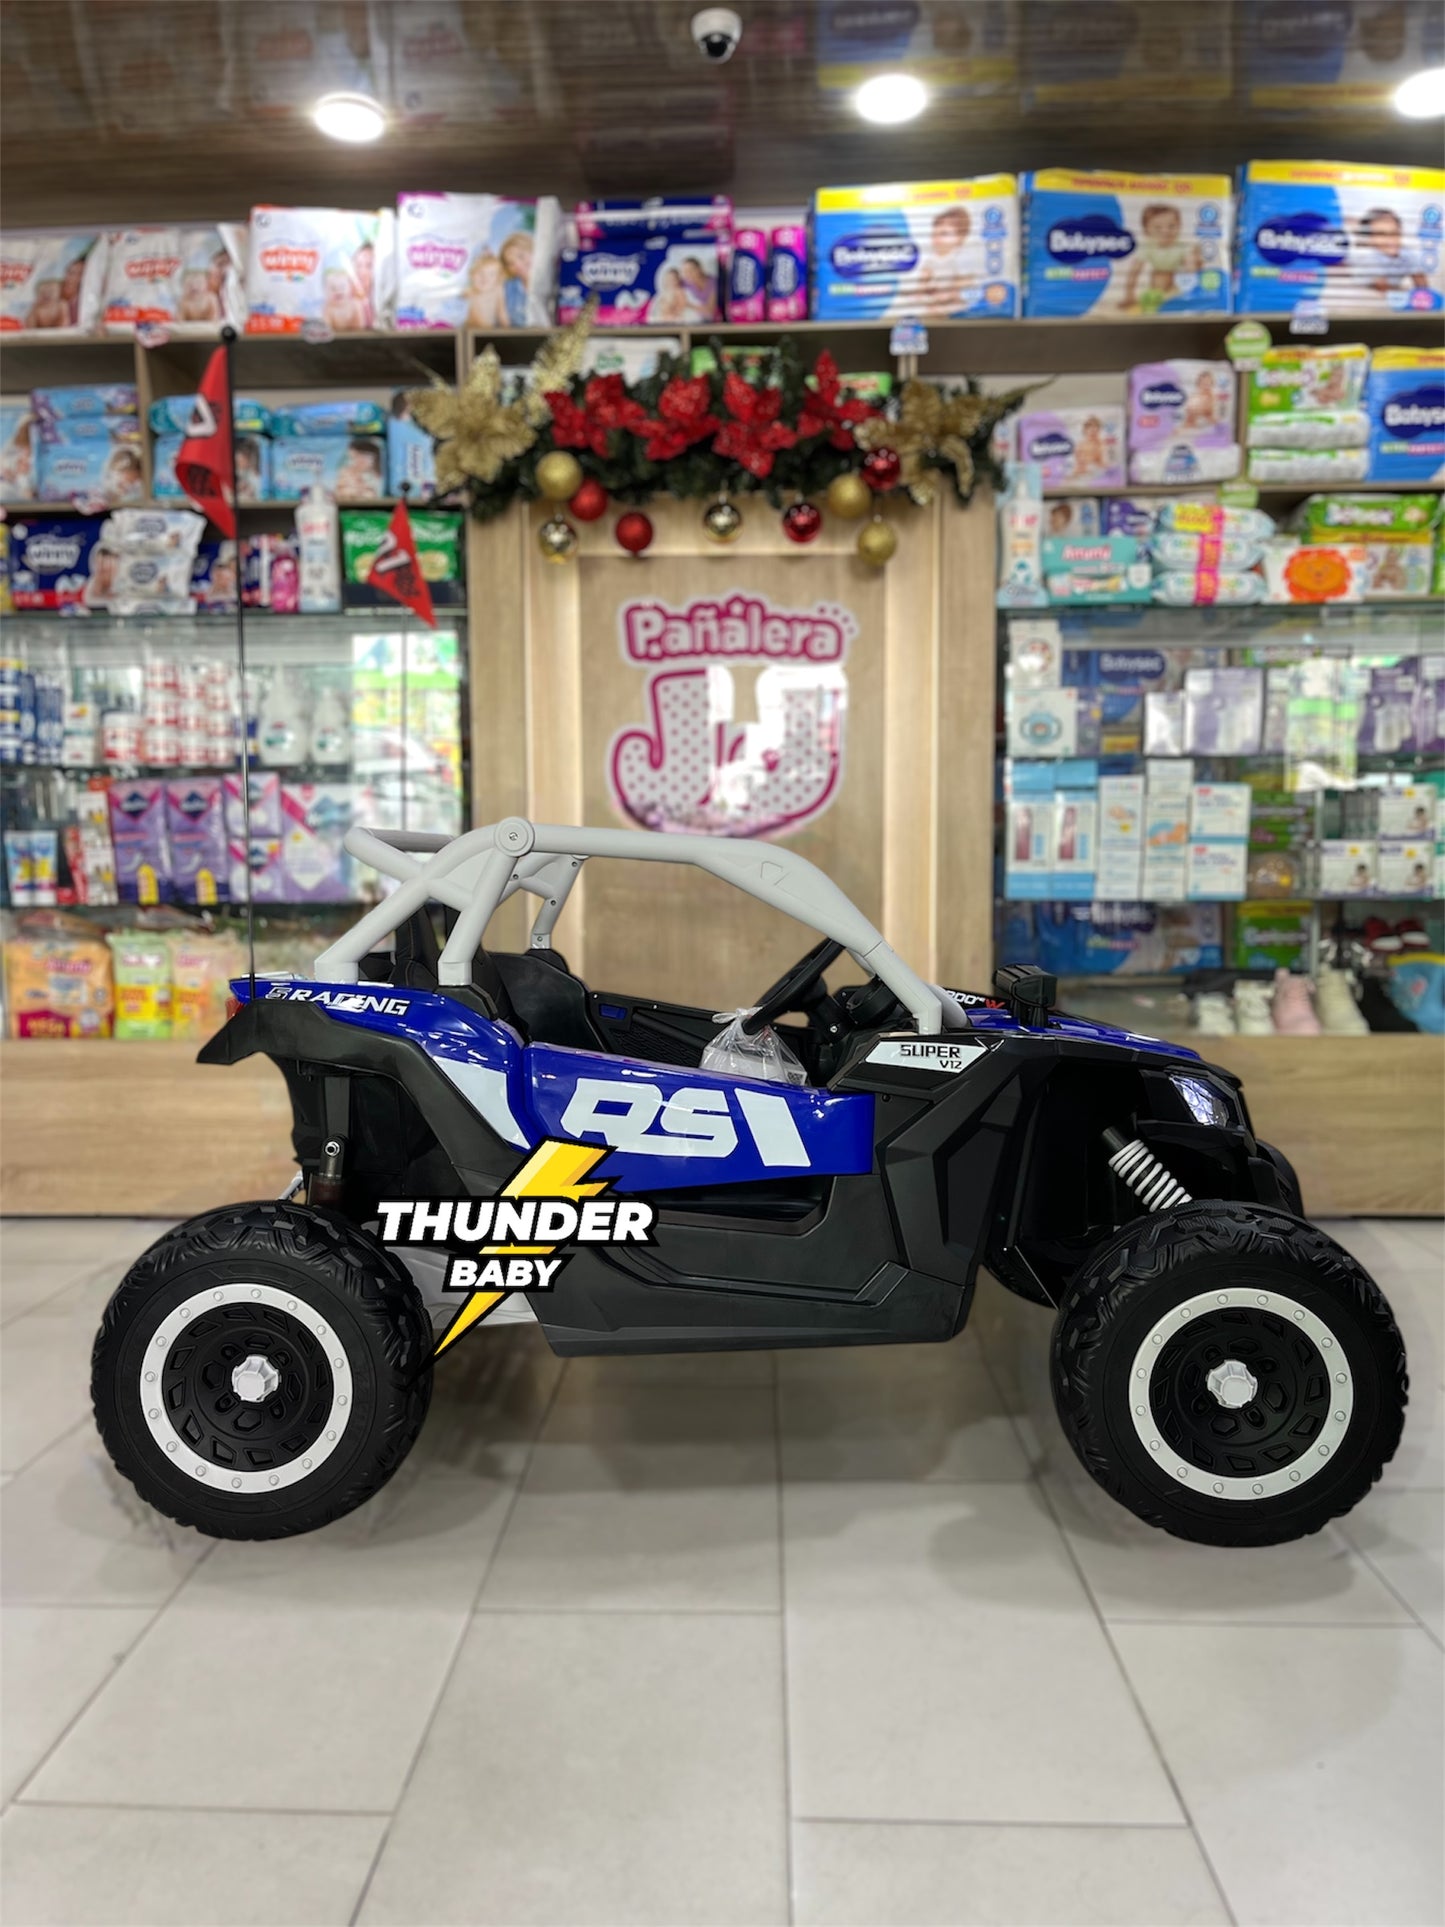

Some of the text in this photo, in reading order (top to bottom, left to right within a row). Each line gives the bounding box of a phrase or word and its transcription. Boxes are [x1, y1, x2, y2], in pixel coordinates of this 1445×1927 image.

[1050, 229, 1132, 255] Babysec
[630, 598, 841, 660] Pañalera
[940, 1060, 962, 1069] V12
